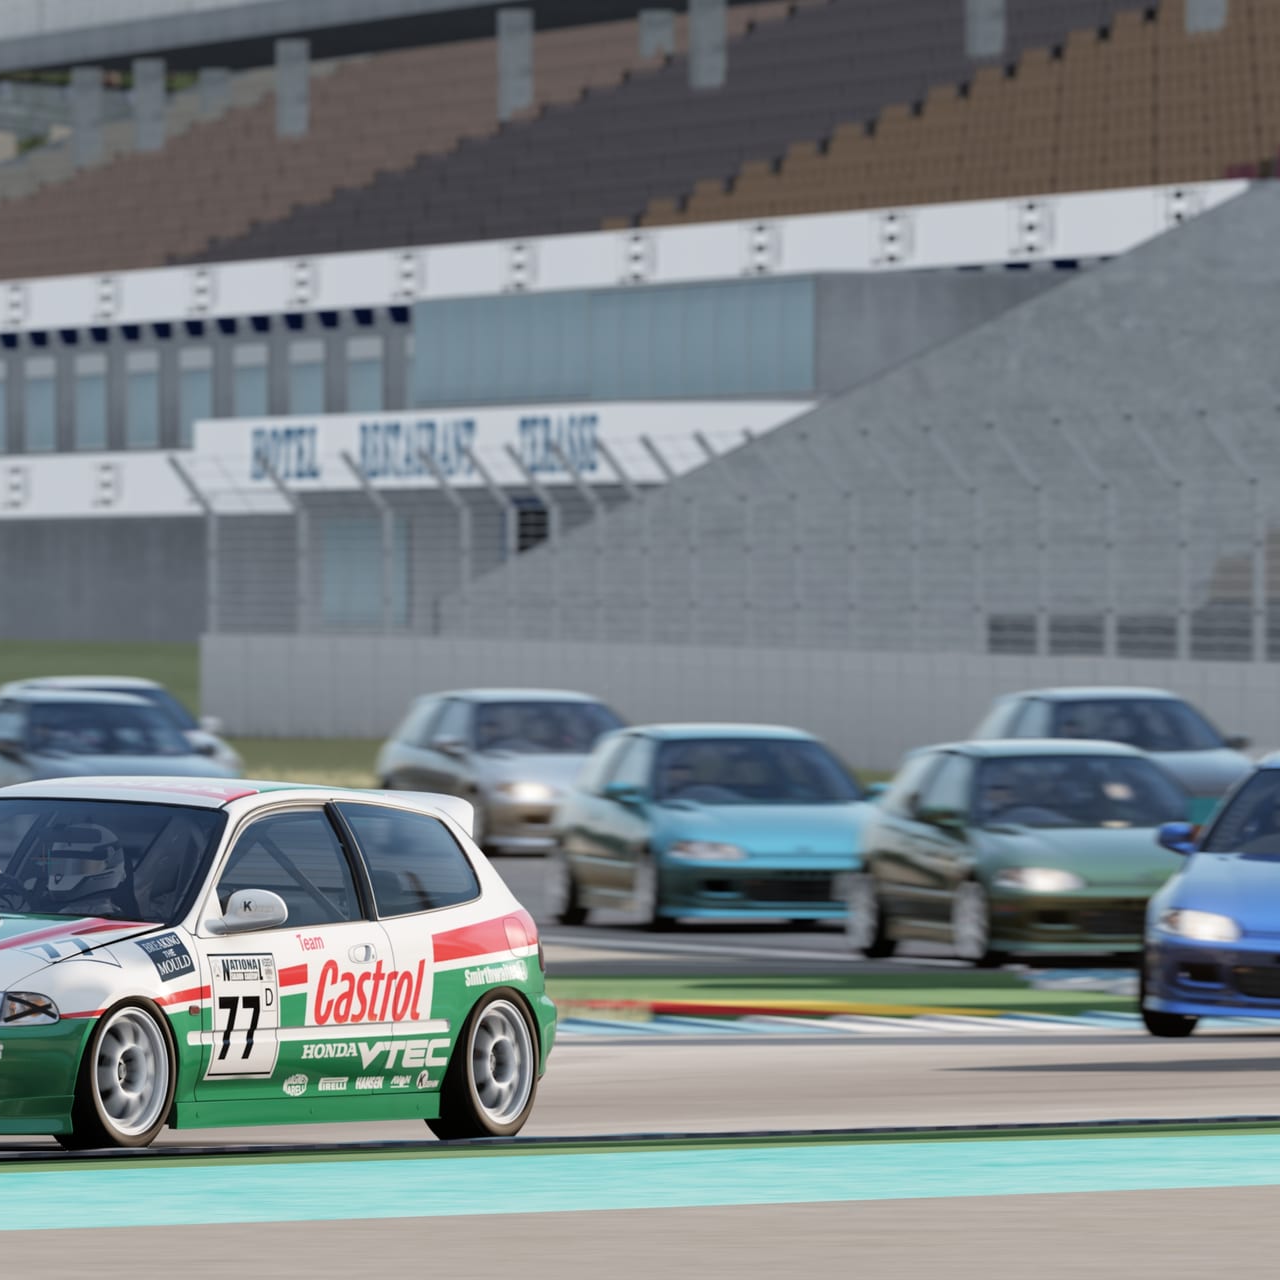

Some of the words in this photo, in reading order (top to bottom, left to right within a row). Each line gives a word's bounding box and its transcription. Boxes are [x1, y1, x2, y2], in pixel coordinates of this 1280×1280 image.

[250, 426, 320, 480] HOTEL
[142, 935, 181, 954] BREAKING
[163, 948, 177, 958] THE
[296, 934, 325, 952] Team
[156, 955, 191, 976] MOULD
[221, 958, 264, 982] NATIONAL
[265, 987, 274, 1007] D
[314, 958, 426, 1026] Castrol
[218, 995, 261, 1060] 77
[301, 1042, 359, 1060] HONDA
[357, 1038, 451, 1070] VTEC
[318, 1077, 349, 1092] PIRELLI
[355, 1076, 385, 1090] HANSEN
